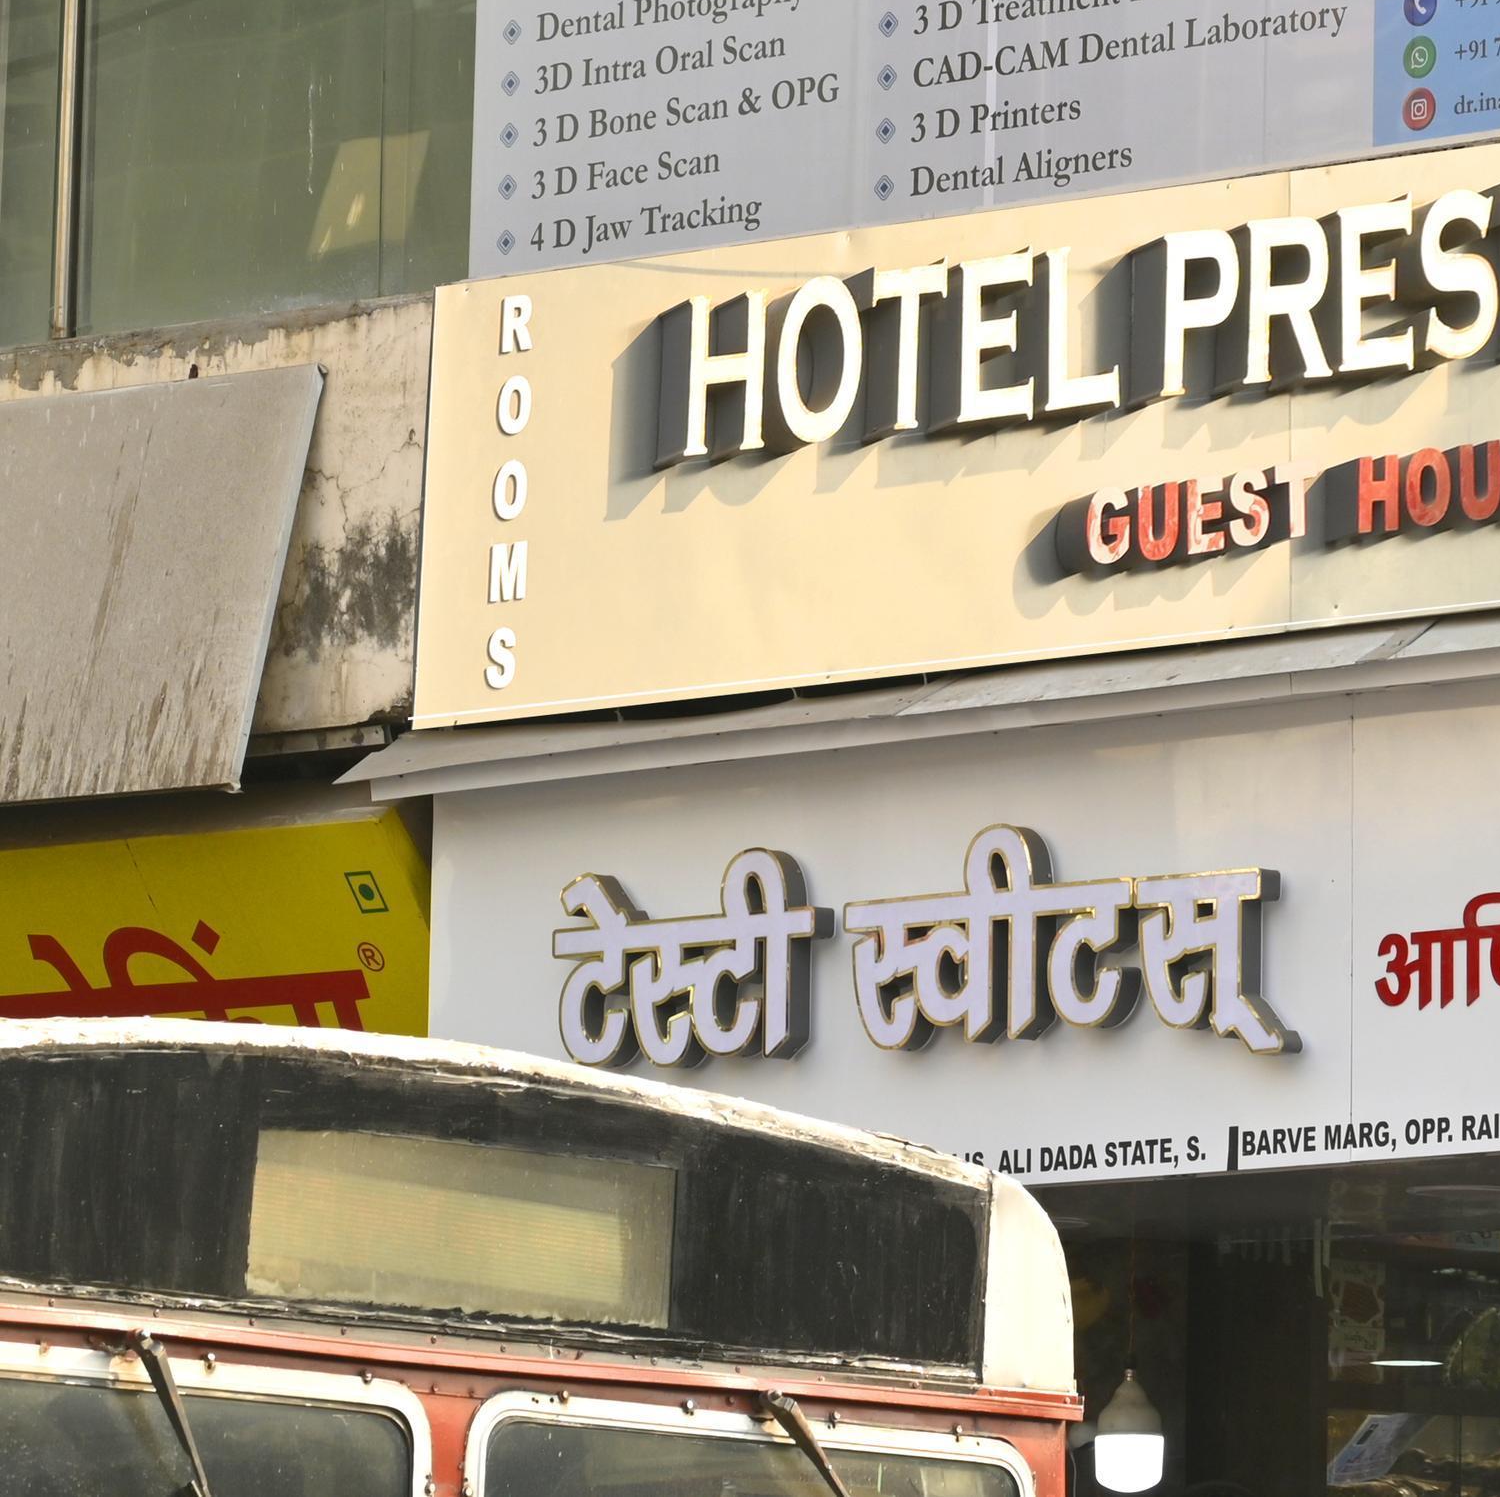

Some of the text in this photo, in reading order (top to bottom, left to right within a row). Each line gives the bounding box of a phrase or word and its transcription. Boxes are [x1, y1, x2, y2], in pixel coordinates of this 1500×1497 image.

[535, 31, 787, 96] 3D Intra Oral Scan
[537, 0, 626, 44] Dental
[913, 2, 1349, 89] CAD-CAM Dental Laboratory
[1454, 38, 1488, 62] +91
[684, 246, 1121, 459] HOTEL
[484, 295, 534, 692] ROOMS
[1087, 462, 1317, 565] GUEST
[551, 846, 814, 1068] टेस्टी
[843, 823, 1284, 1055] स्वीटस्
[998, 1137, 1182, 1177] ALI DADA STATE,
